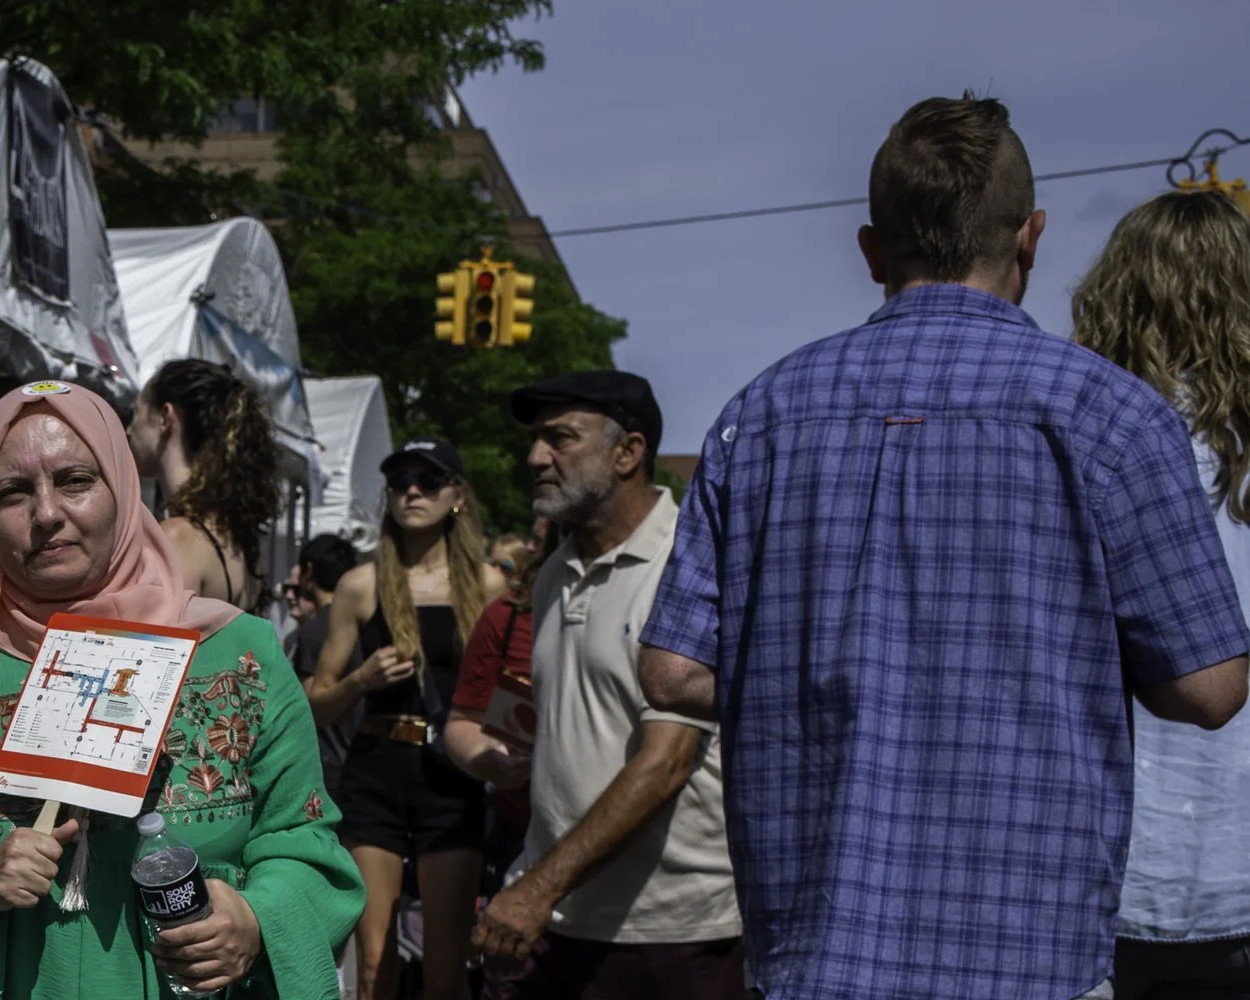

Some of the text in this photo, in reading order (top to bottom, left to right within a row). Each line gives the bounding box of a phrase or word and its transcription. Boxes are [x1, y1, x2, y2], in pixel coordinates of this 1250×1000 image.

[165, 881, 194, 898] SOLID
[168, 887, 196, 905] ROCK
[170, 897, 192, 911] CITY
